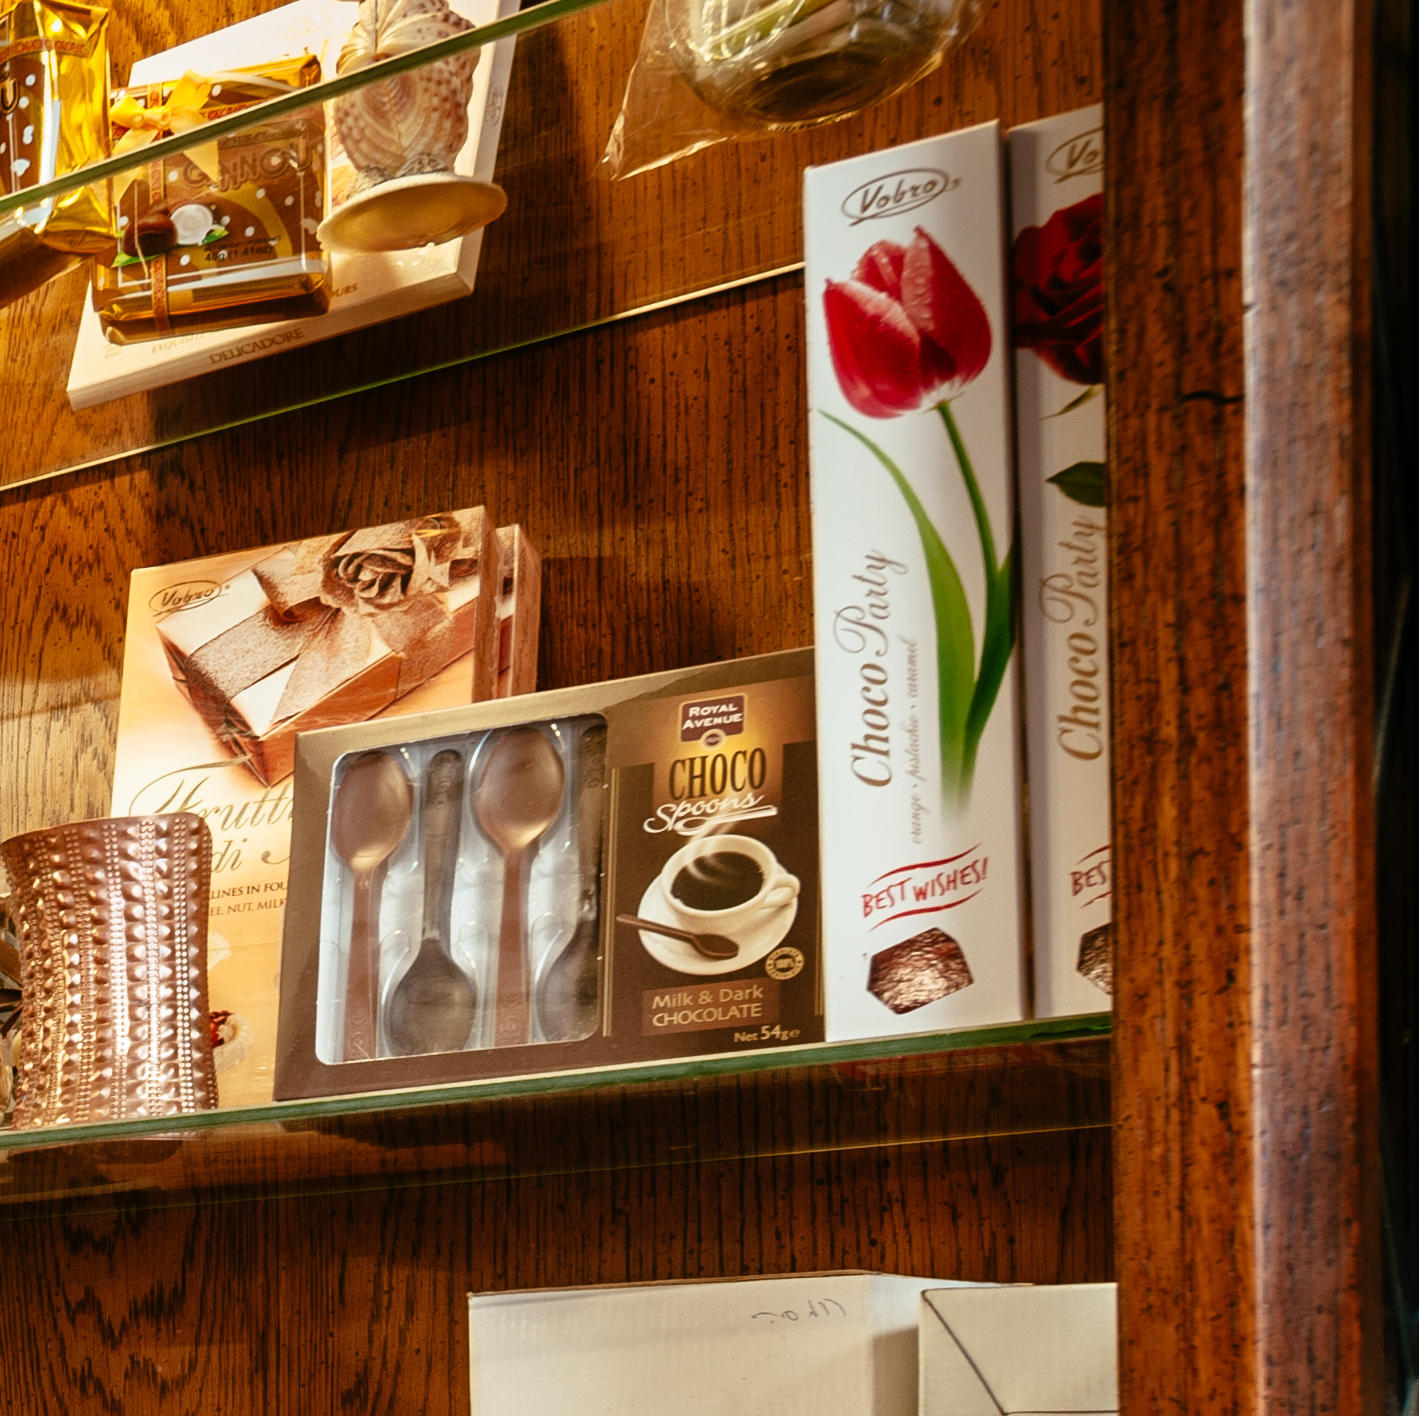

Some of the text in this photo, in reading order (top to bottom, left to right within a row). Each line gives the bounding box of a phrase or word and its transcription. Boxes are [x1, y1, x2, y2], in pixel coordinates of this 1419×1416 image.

[855, 171, 942, 214] Vobro
[210, 327, 305, 364] DELICADORE
[833, 549, 909, 788] Choco Party
[688, 701, 739, 717] ROYAL
[1057, 632, 1103, 762] Choco
[682, 713, 744, 731] AVENUE
[668, 747, 767, 801] CHOCO
[643, 792, 766, 834] Spoons
[246, 883, 262, 896] IN
[263, 880, 289, 895] FOU
[861, 857, 989, 919] BEST WISHES!
[1069, 860, 1110, 897] BES
[652, 984, 764, 1009] Milk & Dark
[652, 1003, 763, 1028] CHOCOLATE
